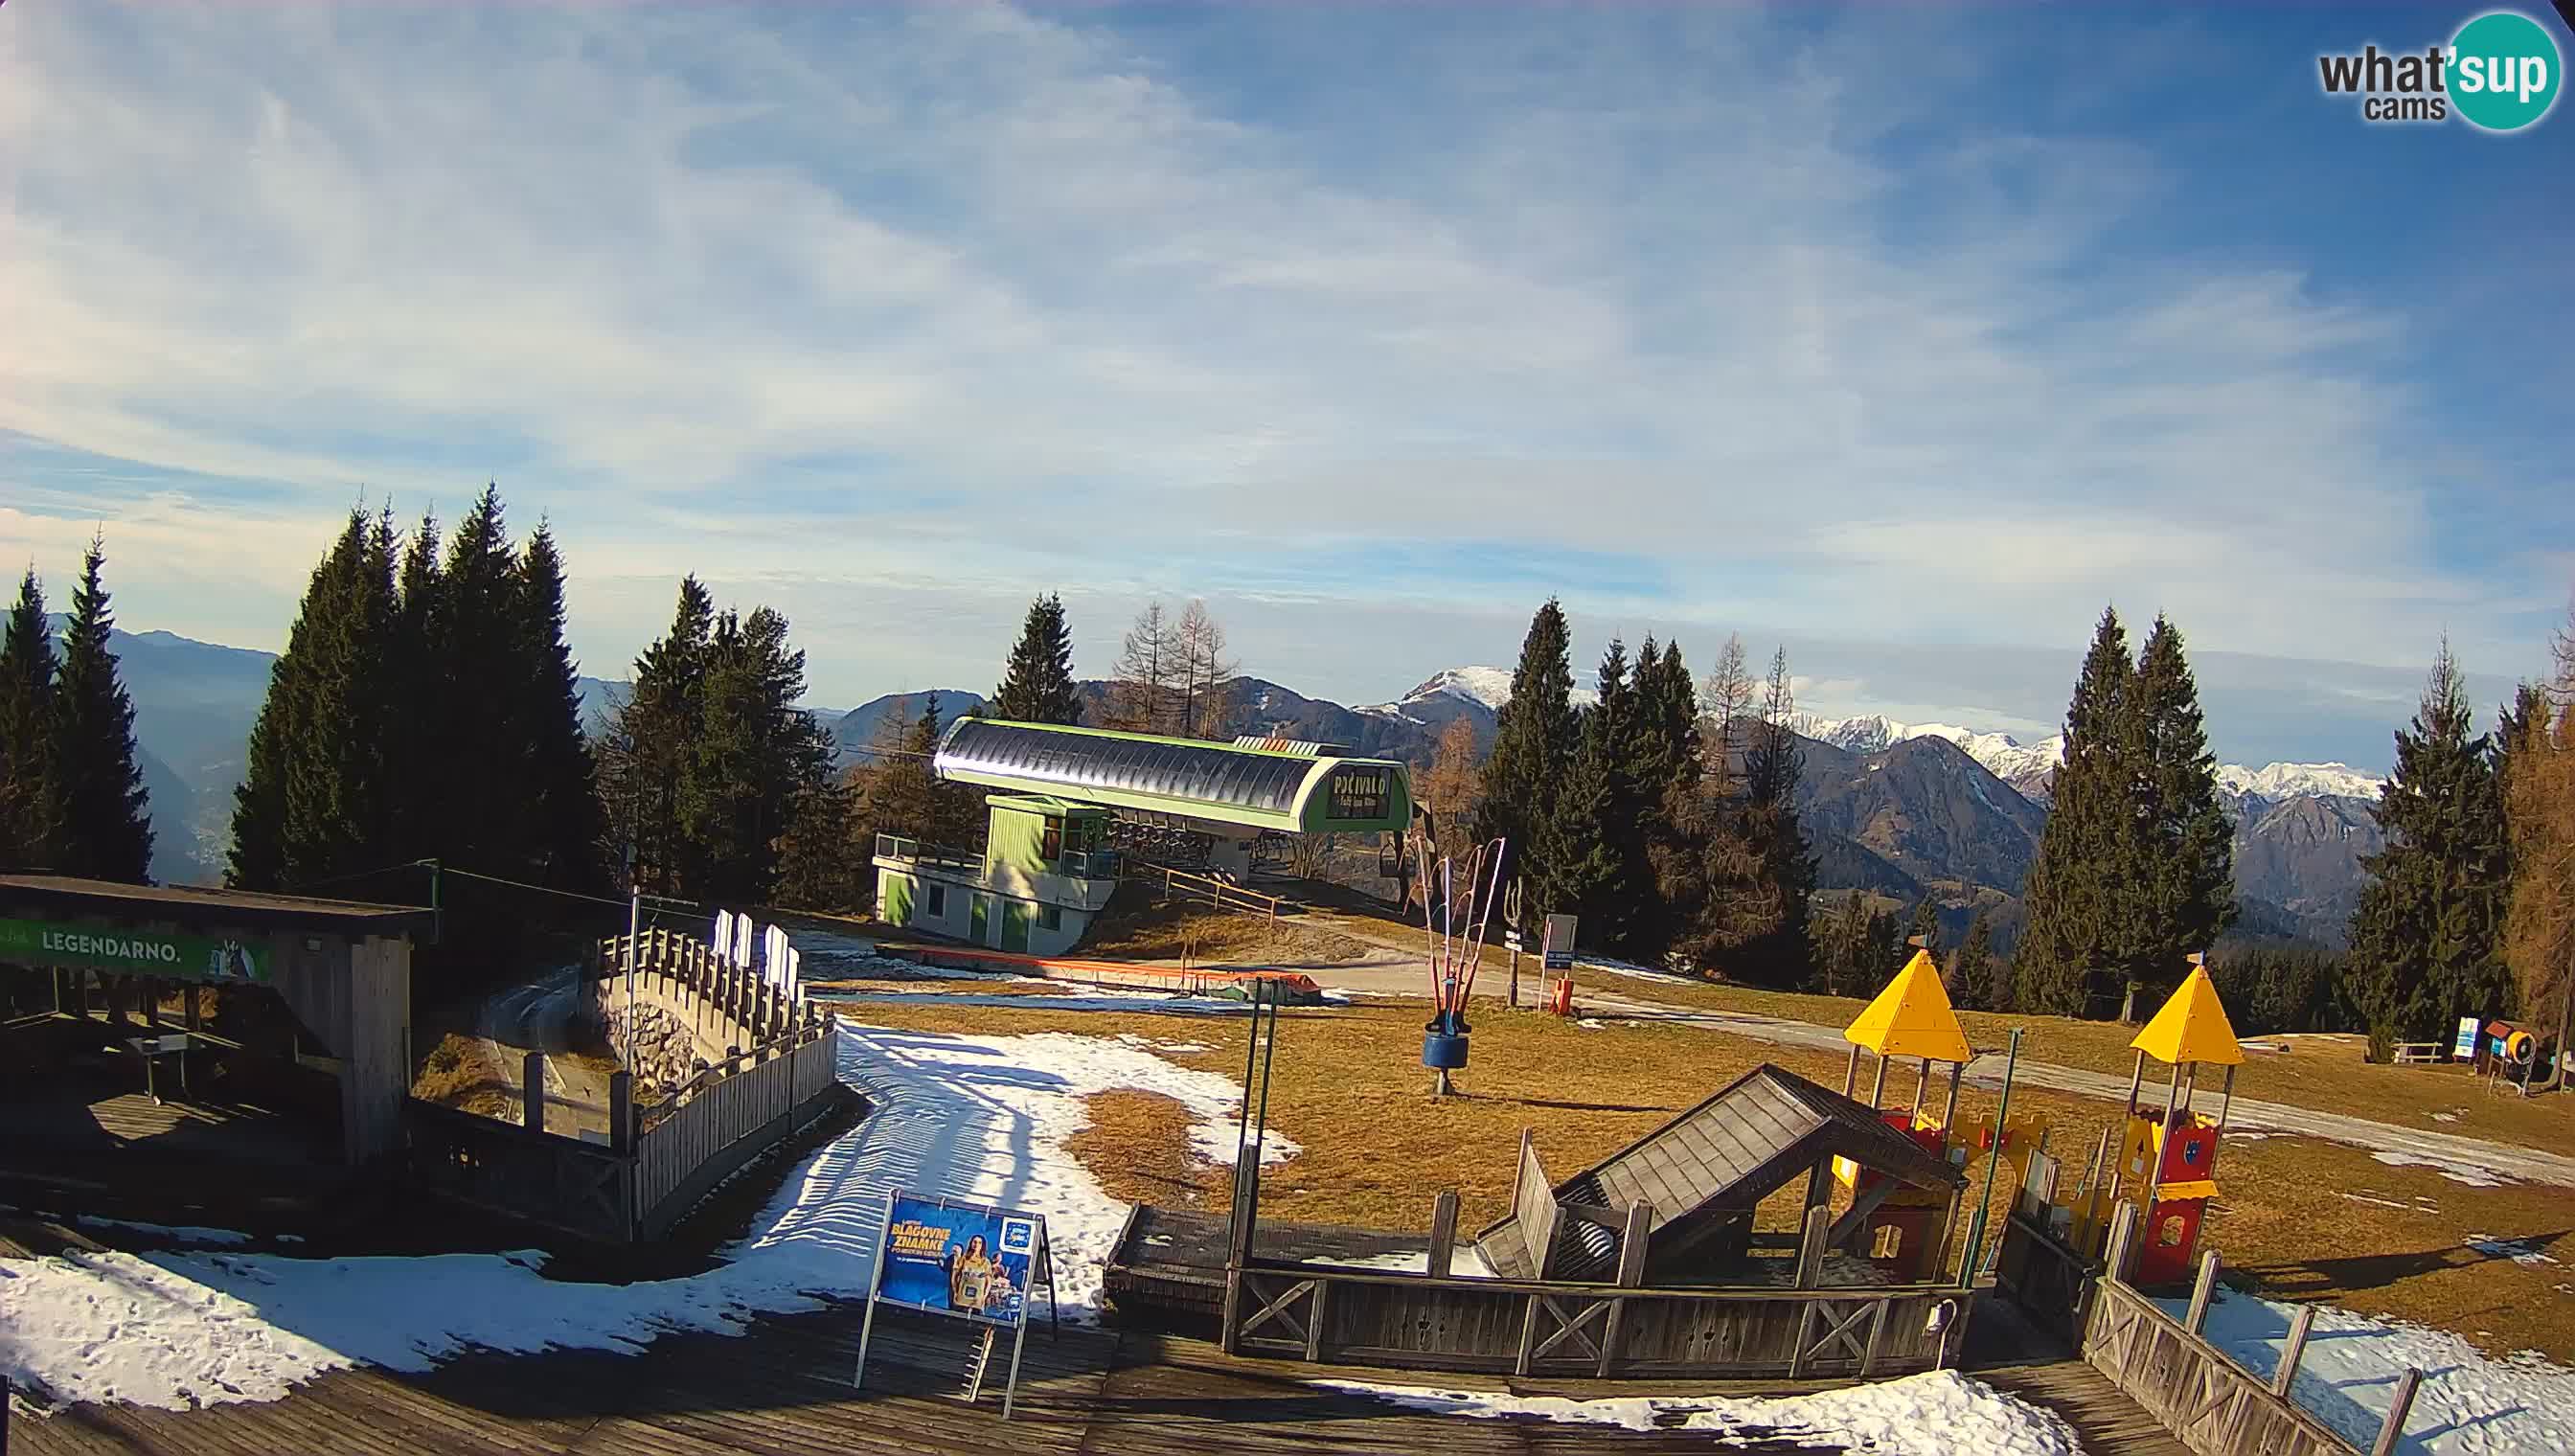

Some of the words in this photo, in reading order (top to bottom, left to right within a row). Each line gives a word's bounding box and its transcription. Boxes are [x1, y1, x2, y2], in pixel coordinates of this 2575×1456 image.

[42, 931, 181, 963] LEGENDARNO.
[891, 1223, 951, 1241] BLAGOVNE
[893, 1236, 945, 1251] ZNAMKE
